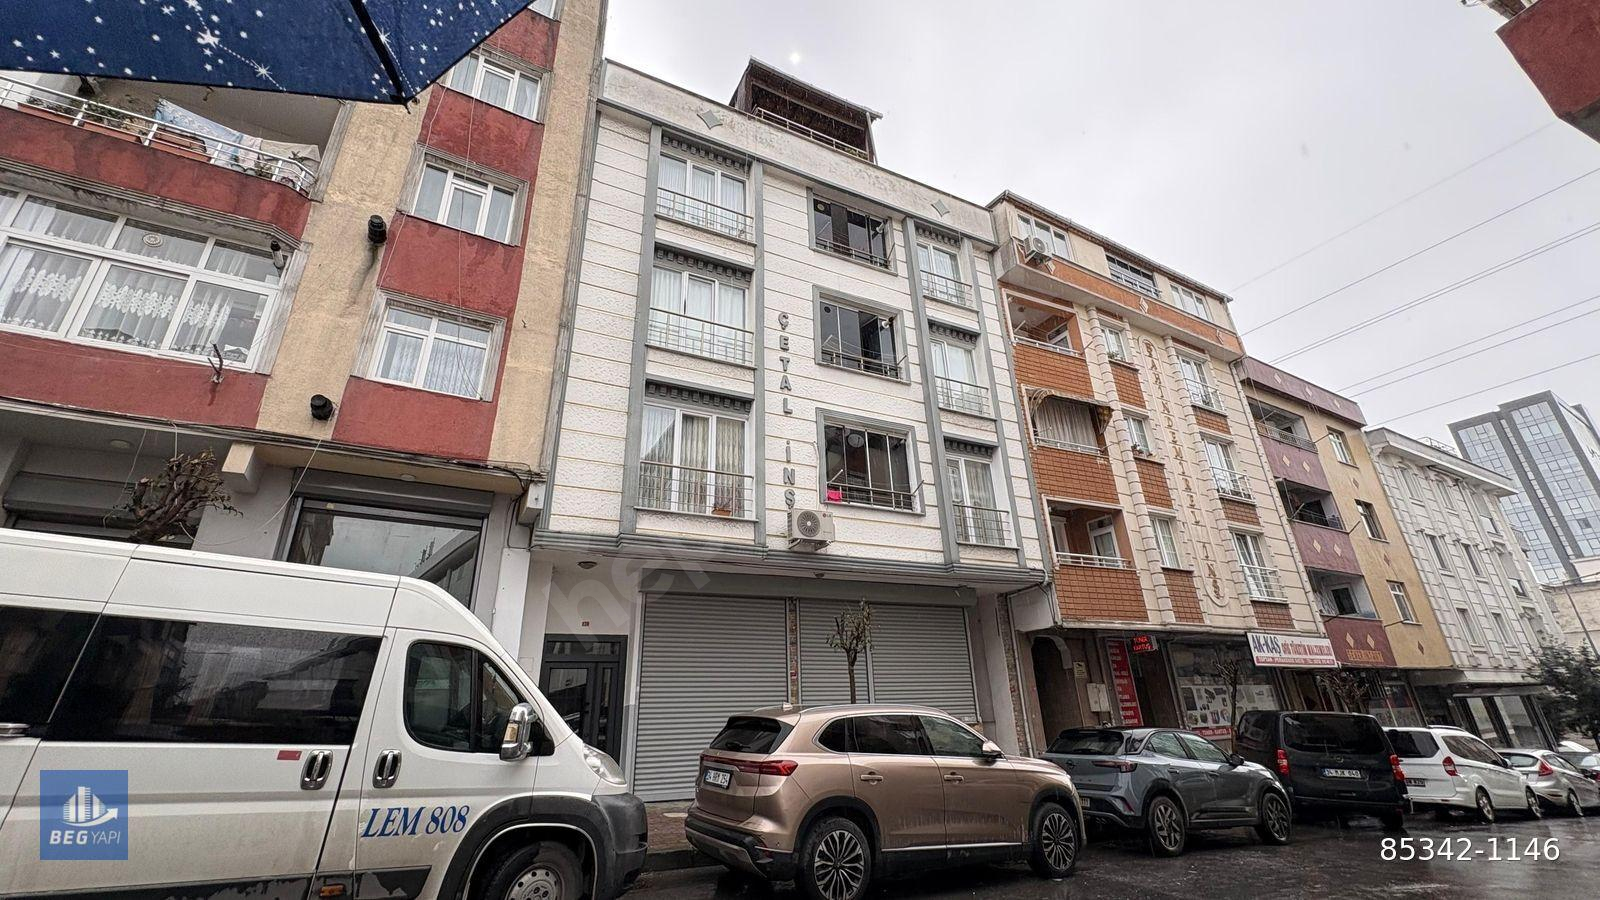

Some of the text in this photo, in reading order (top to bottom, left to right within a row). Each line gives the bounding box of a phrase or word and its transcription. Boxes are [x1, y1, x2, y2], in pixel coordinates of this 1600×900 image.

[778, 312, 793, 415] ÇETAL
[1252, 634, 1282, 656] AK-KAŞ
[361, 805, 470, 837] LEM 808
